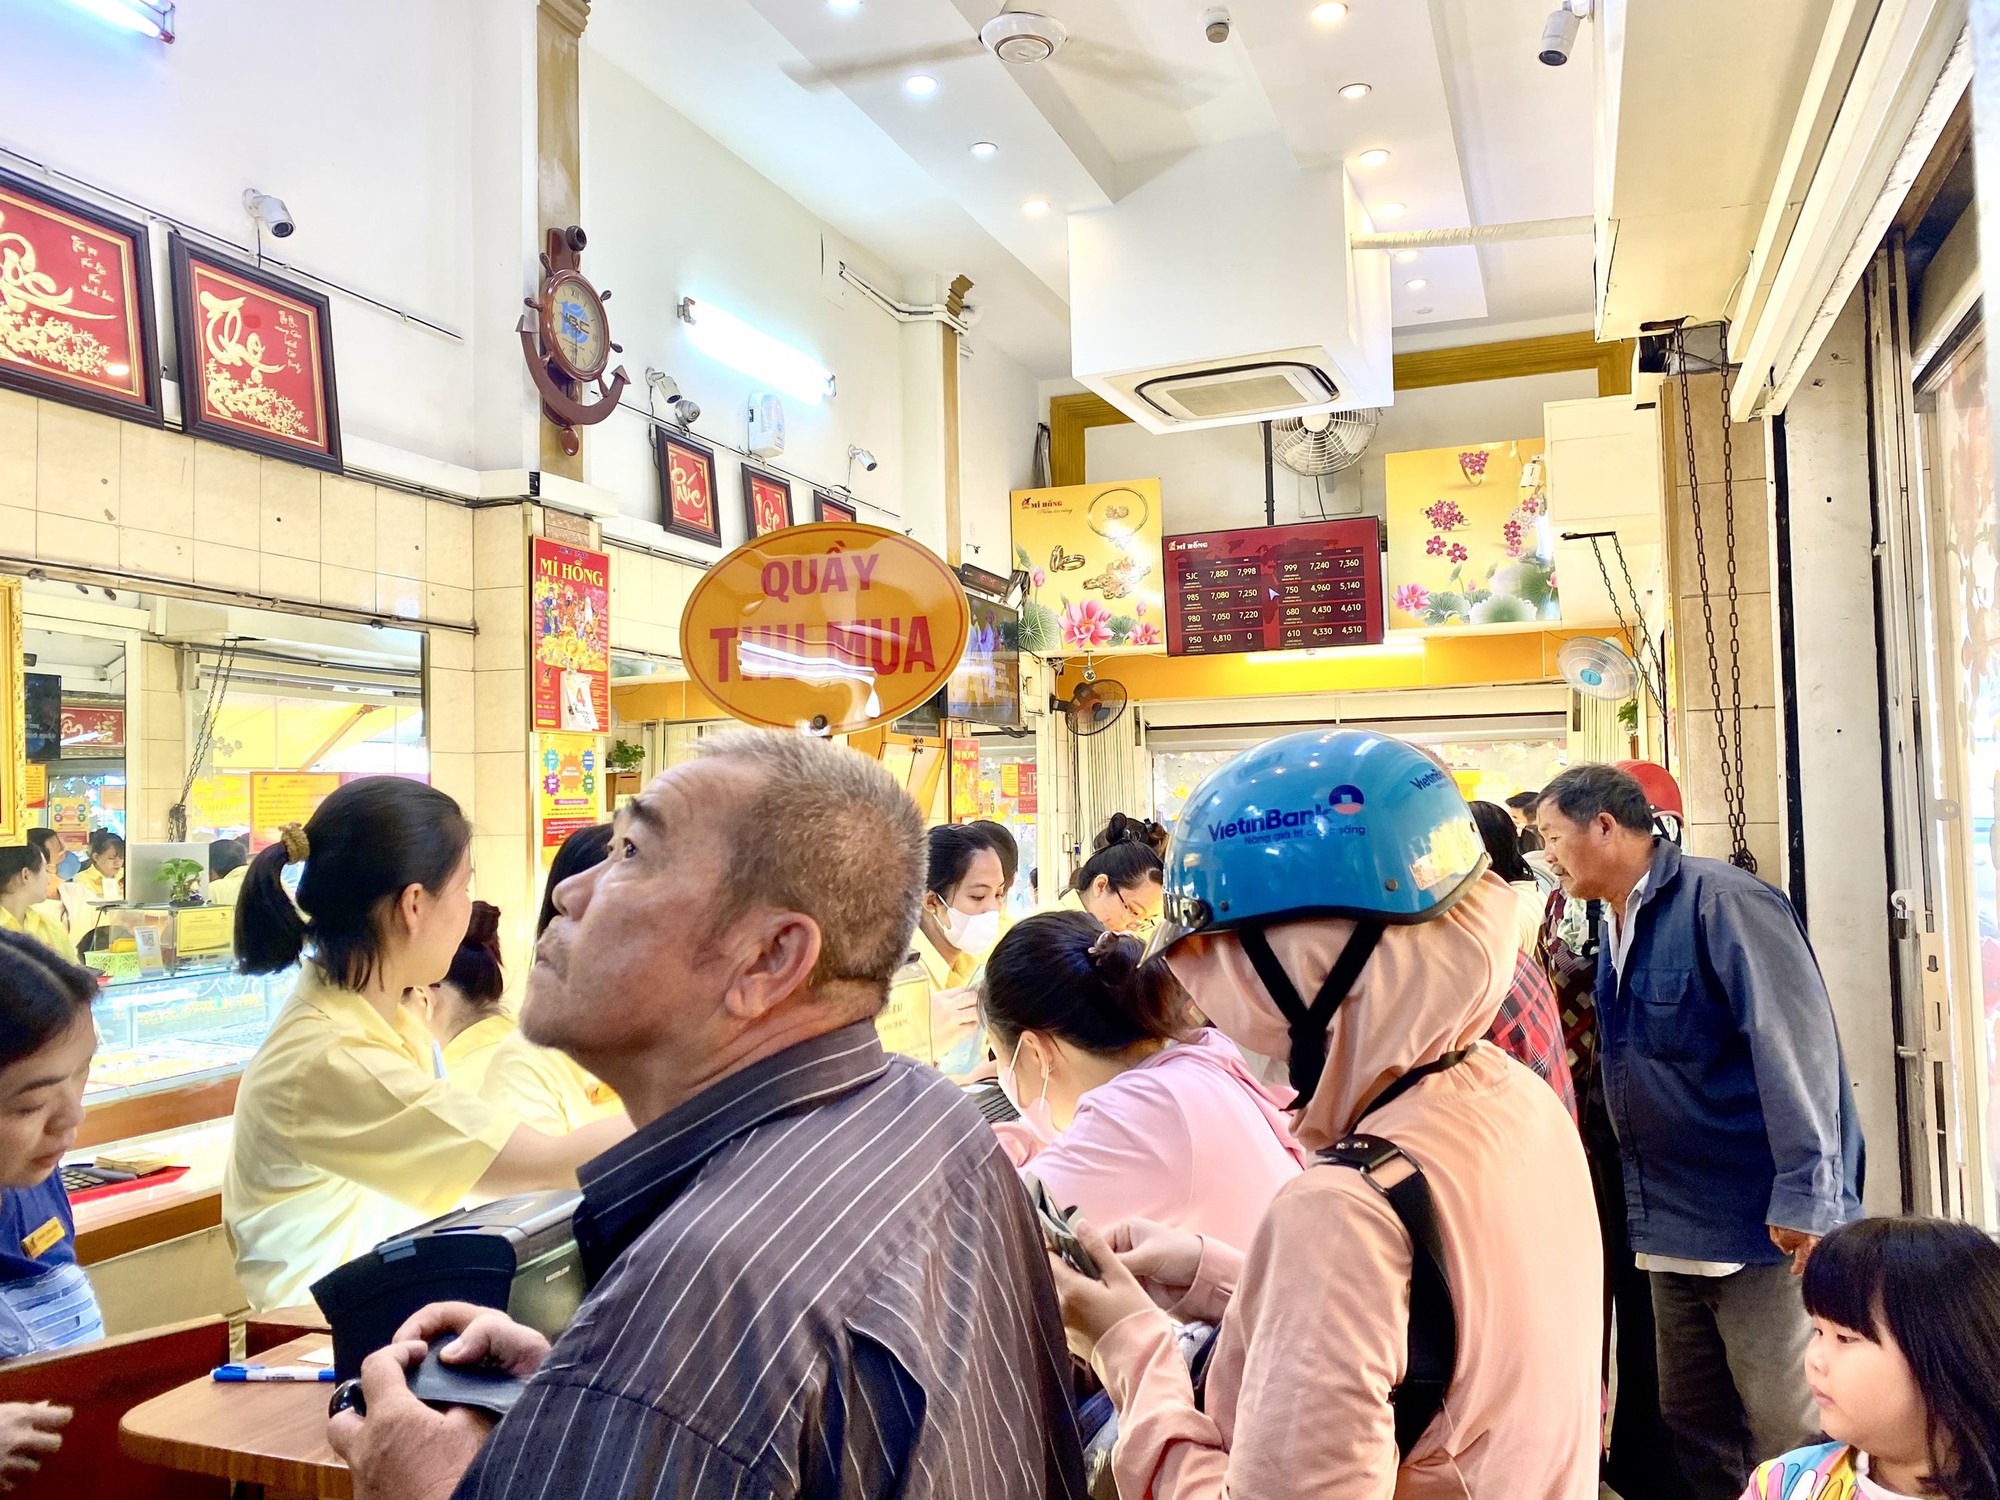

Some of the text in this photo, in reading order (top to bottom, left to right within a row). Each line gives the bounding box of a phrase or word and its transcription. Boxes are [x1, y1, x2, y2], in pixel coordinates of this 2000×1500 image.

[761, 540, 880, 603] QUẦY
[1283, 558, 1360, 572] 999 7,240 7,360
[562, 557, 604, 587] HỒNG
[1185, 567, 1257, 580] SJC 7,880 7,998
[1285, 581, 1360, 594] 750 4,960 5,140
[1186, 589, 1258, 601] 985 7,080 7,250
[1187, 610, 1259, 622] 980 7,050 7,220
[1286, 603, 1361, 616] 680 4,430 4,610
[1286, 625, 1362, 637] 610 4,330 4,510
[1188, 632, 1253, 644] 950 6,810 0
[827, 615, 937, 678] MUA
[1208, 804, 1332, 842] VietinBank
[1306, 827, 1337, 838] cc
